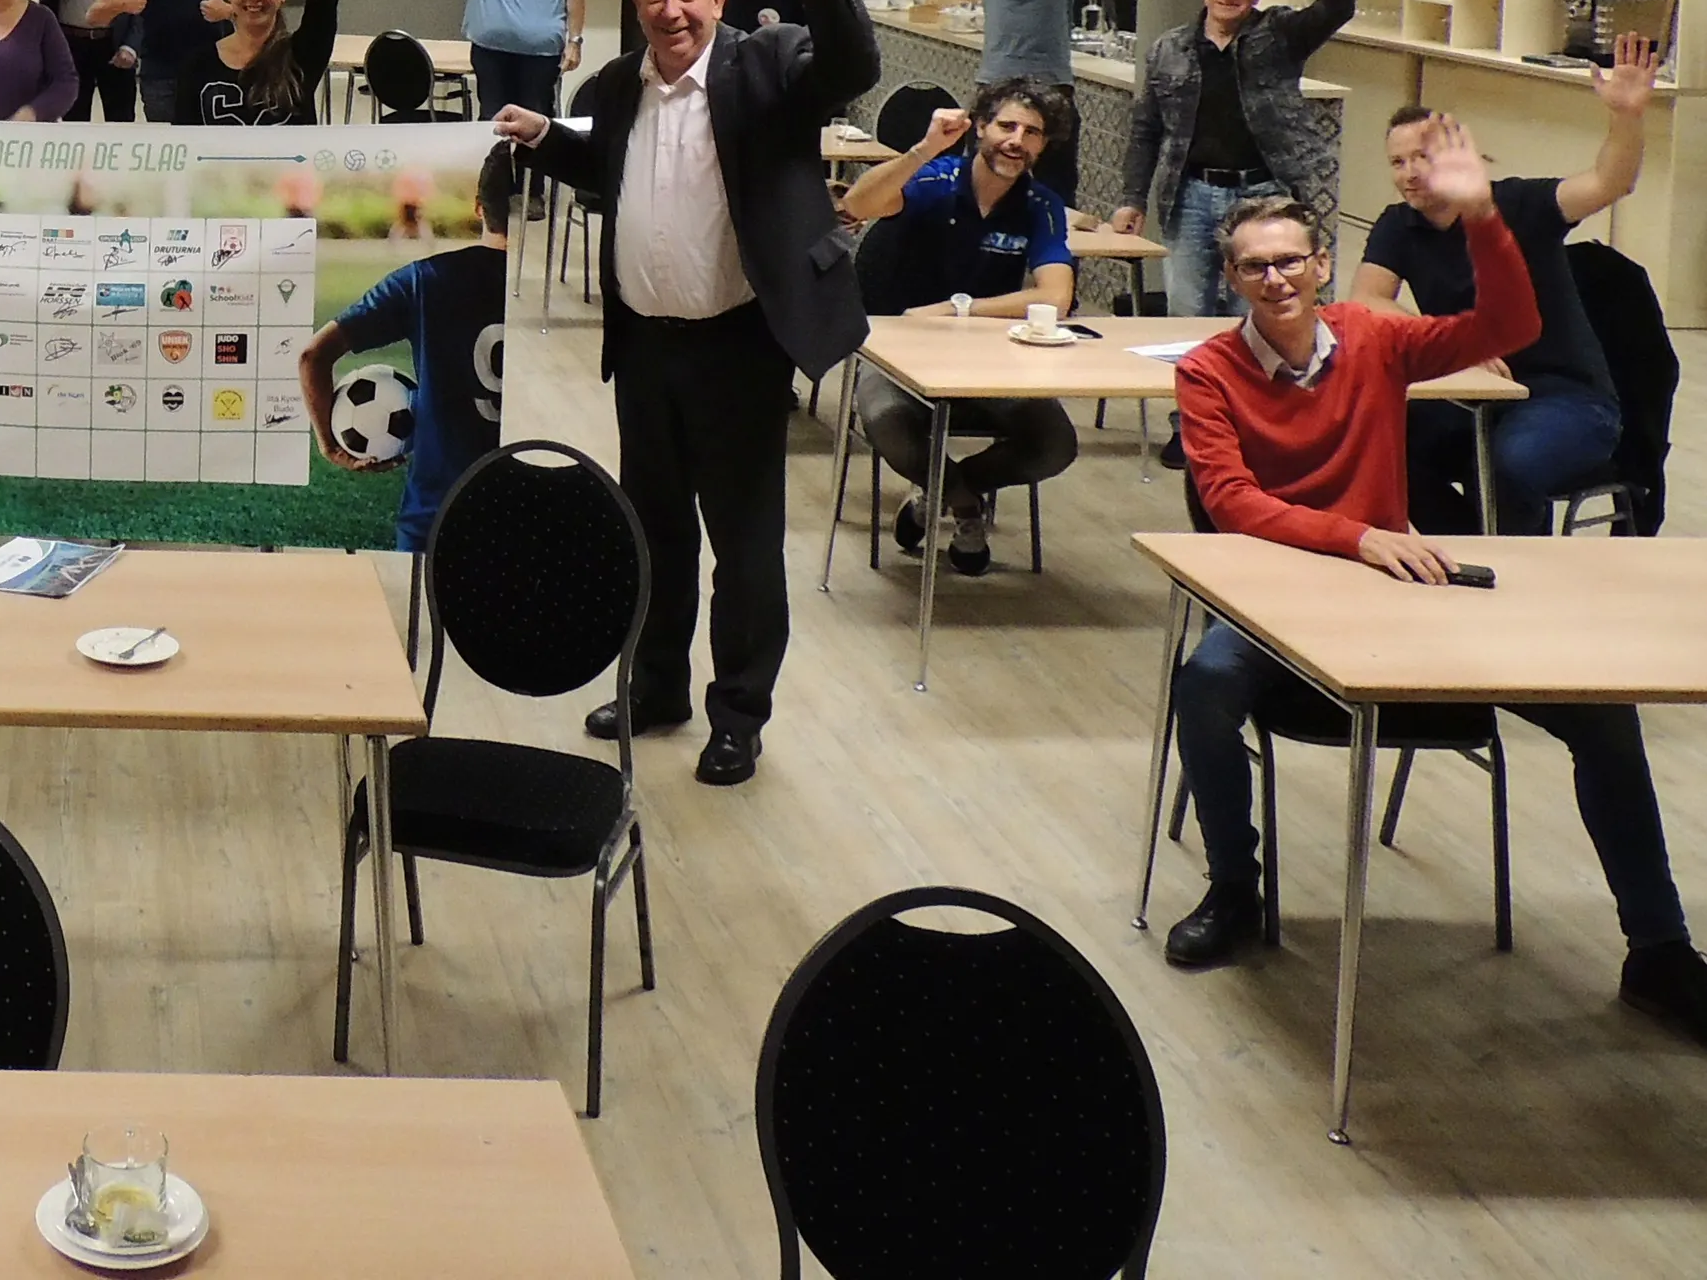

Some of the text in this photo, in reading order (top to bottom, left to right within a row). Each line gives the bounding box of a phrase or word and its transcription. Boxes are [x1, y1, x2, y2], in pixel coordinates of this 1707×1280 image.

[40, 141, 85, 170] AAN
[93, 142, 122, 171] DE
[129, 143, 188, 172] SLAG
[217, 335, 239, 344] JUDO
[217, 345, 236, 353] SHO
[217, 355, 238, 363] SHIN
